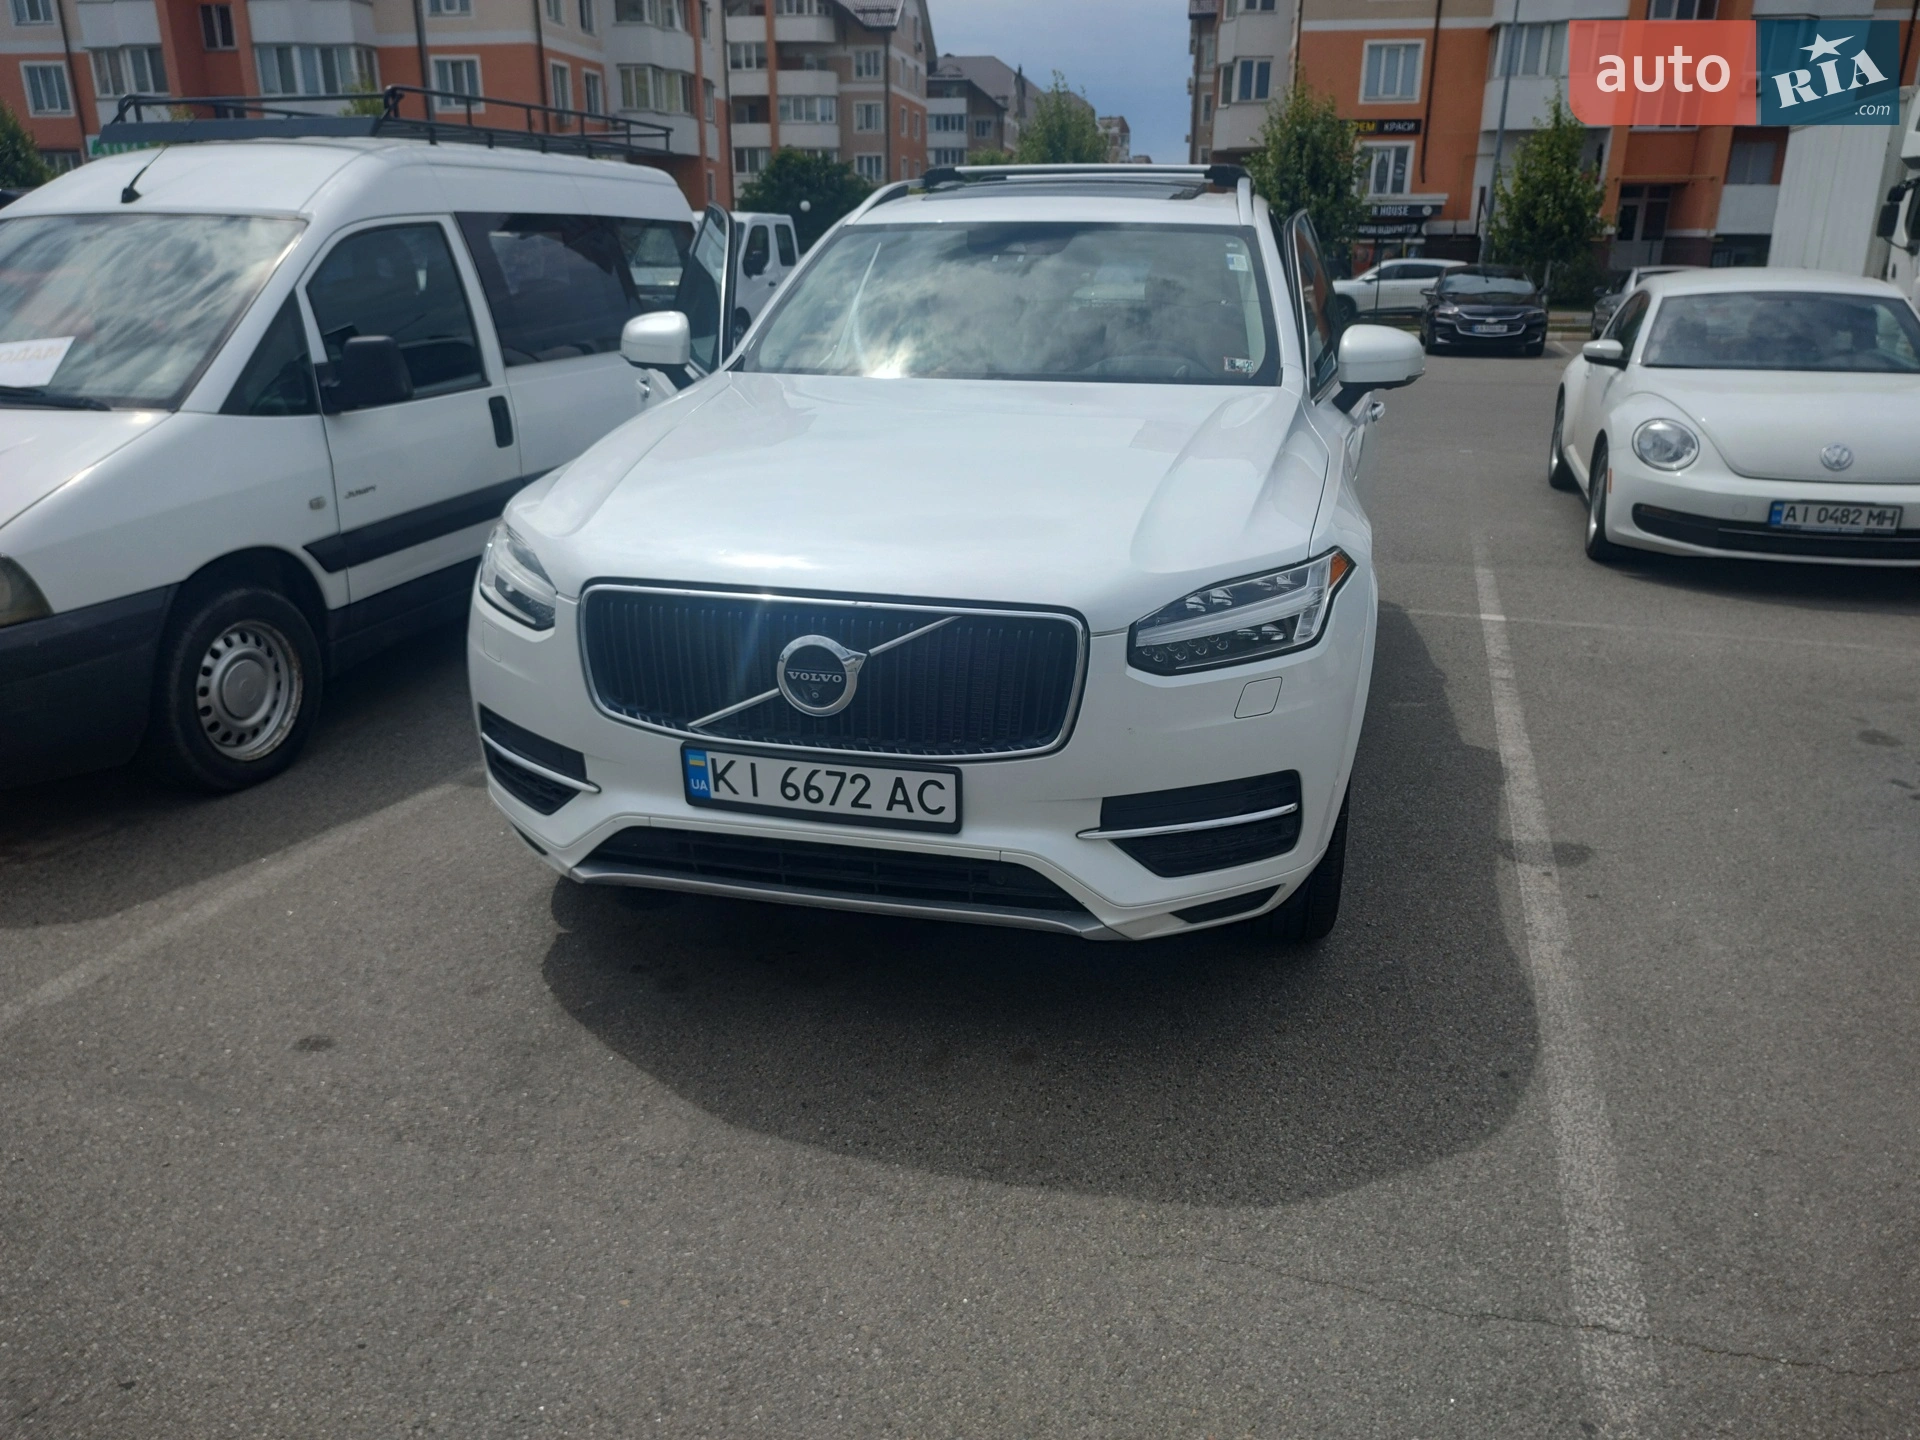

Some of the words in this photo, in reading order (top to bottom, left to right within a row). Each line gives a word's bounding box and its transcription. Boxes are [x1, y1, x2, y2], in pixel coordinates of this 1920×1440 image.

[1380, 205, 1409, 216] HOUSE
[1817, 507, 1863, 526] 0482
[1866, 509, 1898, 527] MH
[787, 671, 843, 683] VOLVO
[691, 778, 708, 791] UA
[710, 757, 760, 798] KI
[780, 766, 872, 809] 6672
[885, 776, 946, 815] AC
